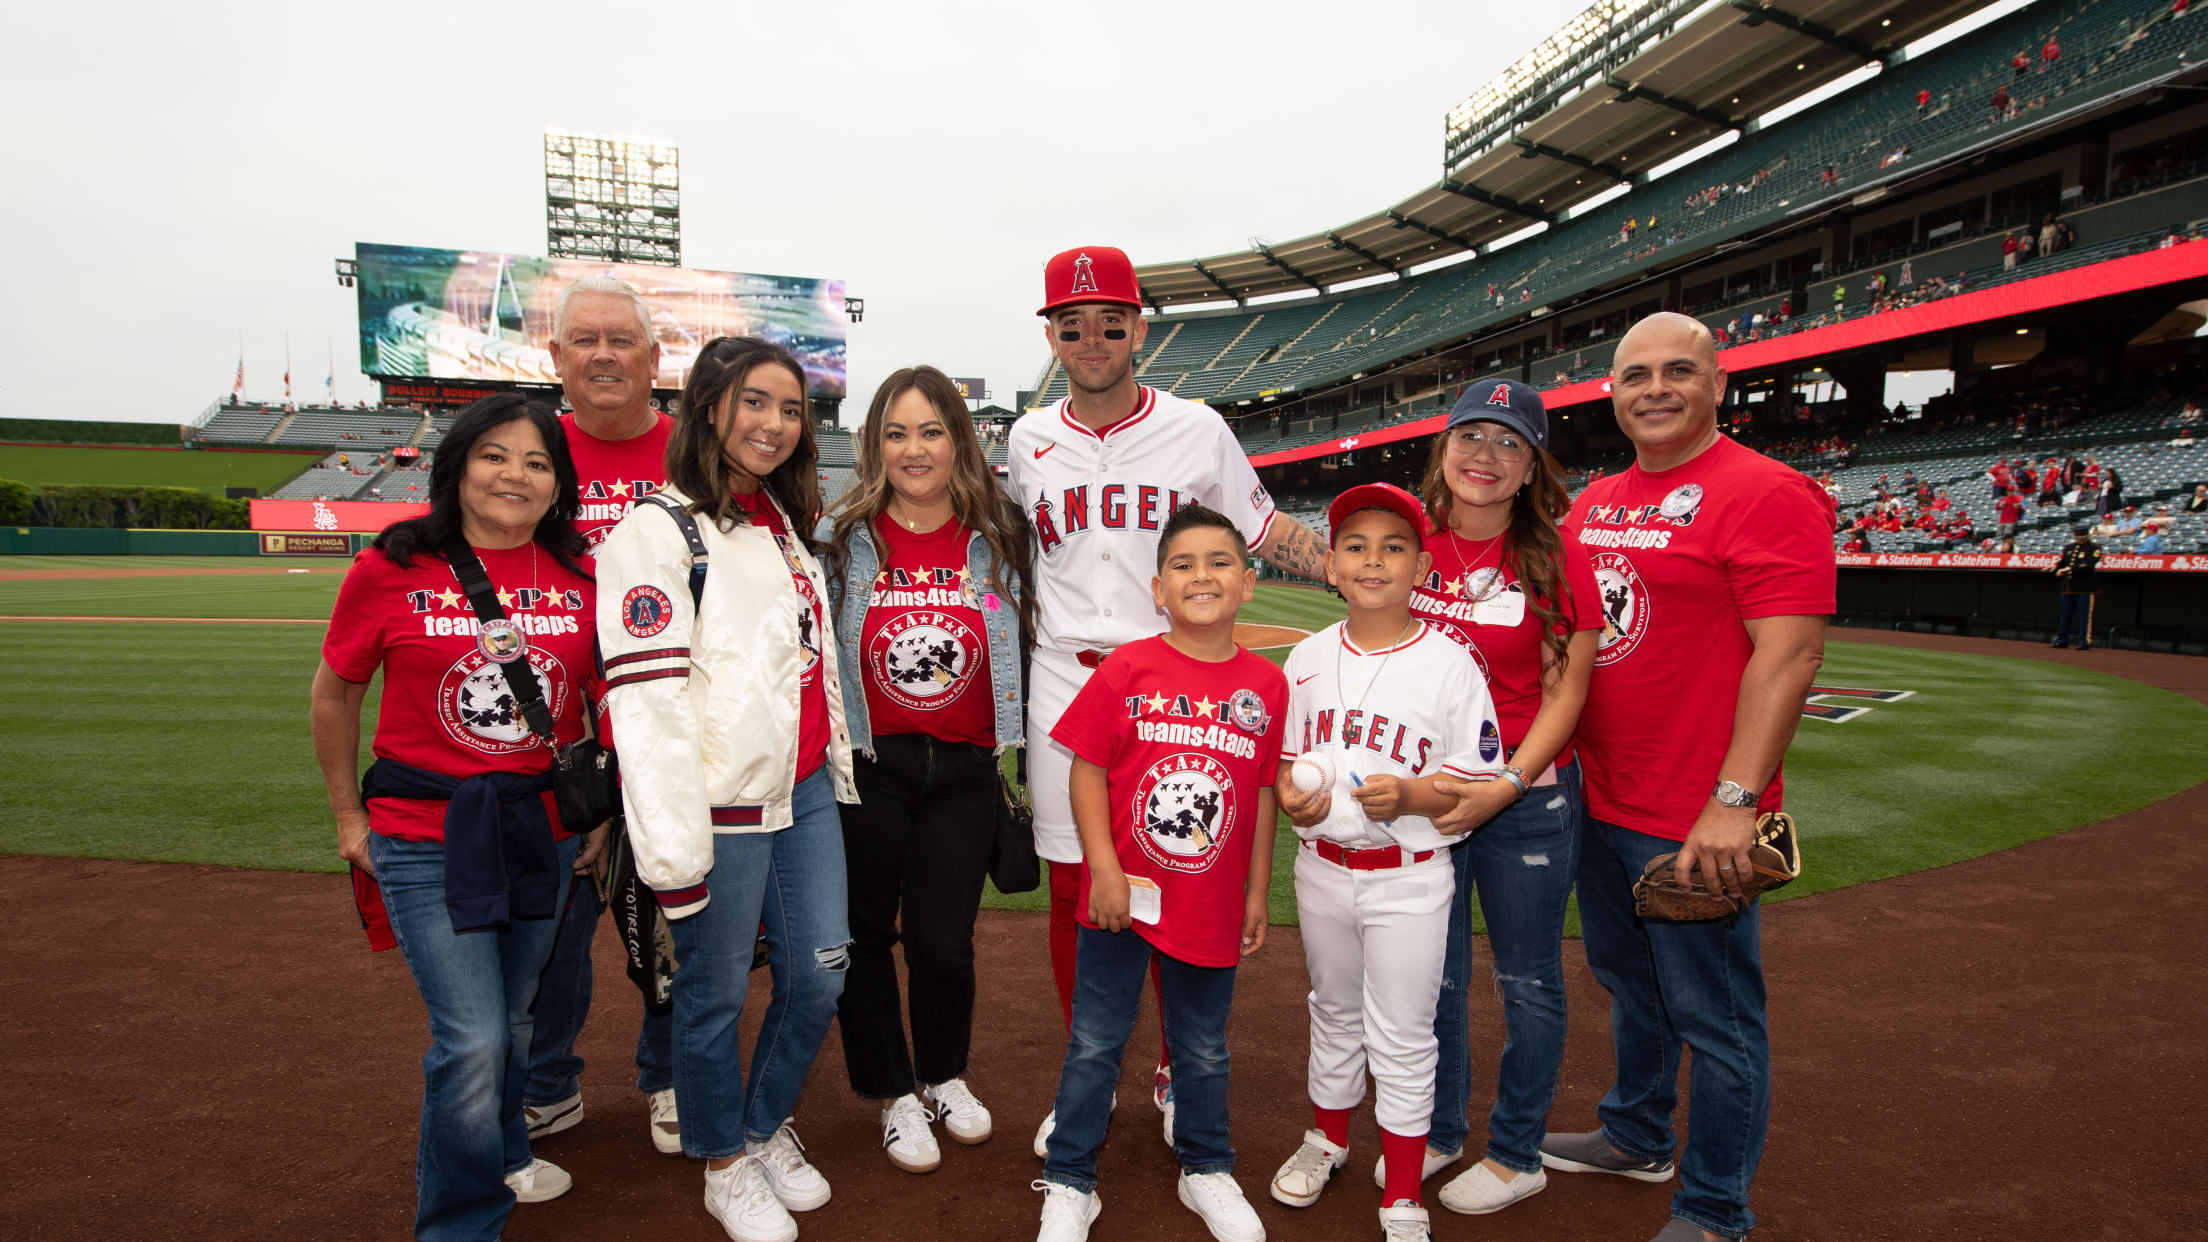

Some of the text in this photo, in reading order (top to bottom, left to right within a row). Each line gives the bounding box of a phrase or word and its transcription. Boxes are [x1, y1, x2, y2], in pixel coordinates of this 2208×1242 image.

[1071, 253, 1099, 294] A
[1486, 383, 1512, 408] A
[288, 538, 345, 546] PECHANGA
[1578, 527, 1673, 550] teams4taps
[1598, 556, 1637, 585] APS
[624, 588, 670, 620] LOS ANGELES
[1628, 597, 1645, 641] SURVIVORS
[628, 620, 666, 637] ANGELS
[880, 614, 968, 642] TAPS
[551, 681, 564, 718] URVIVORS
[881, 677, 919, 708] ASSISTANCE
[920, 694, 954, 708] PROGRAM
[444, 687, 454, 722] TRAGEDY
[450, 721, 497, 750] ASSISTANCE
[1136, 720, 1256, 760] teams4taps
[1301, 708, 1433, 776] ANGELS
[1149, 755, 1232, 792] TAPS
[1134, 790, 1146, 826] TRAGEDY
[1136, 826, 1169, 865] ASSISTANCE
[1215, 805, 1234, 850] SURVIVORS
[1170, 859, 1207, 870] PROGRAM
